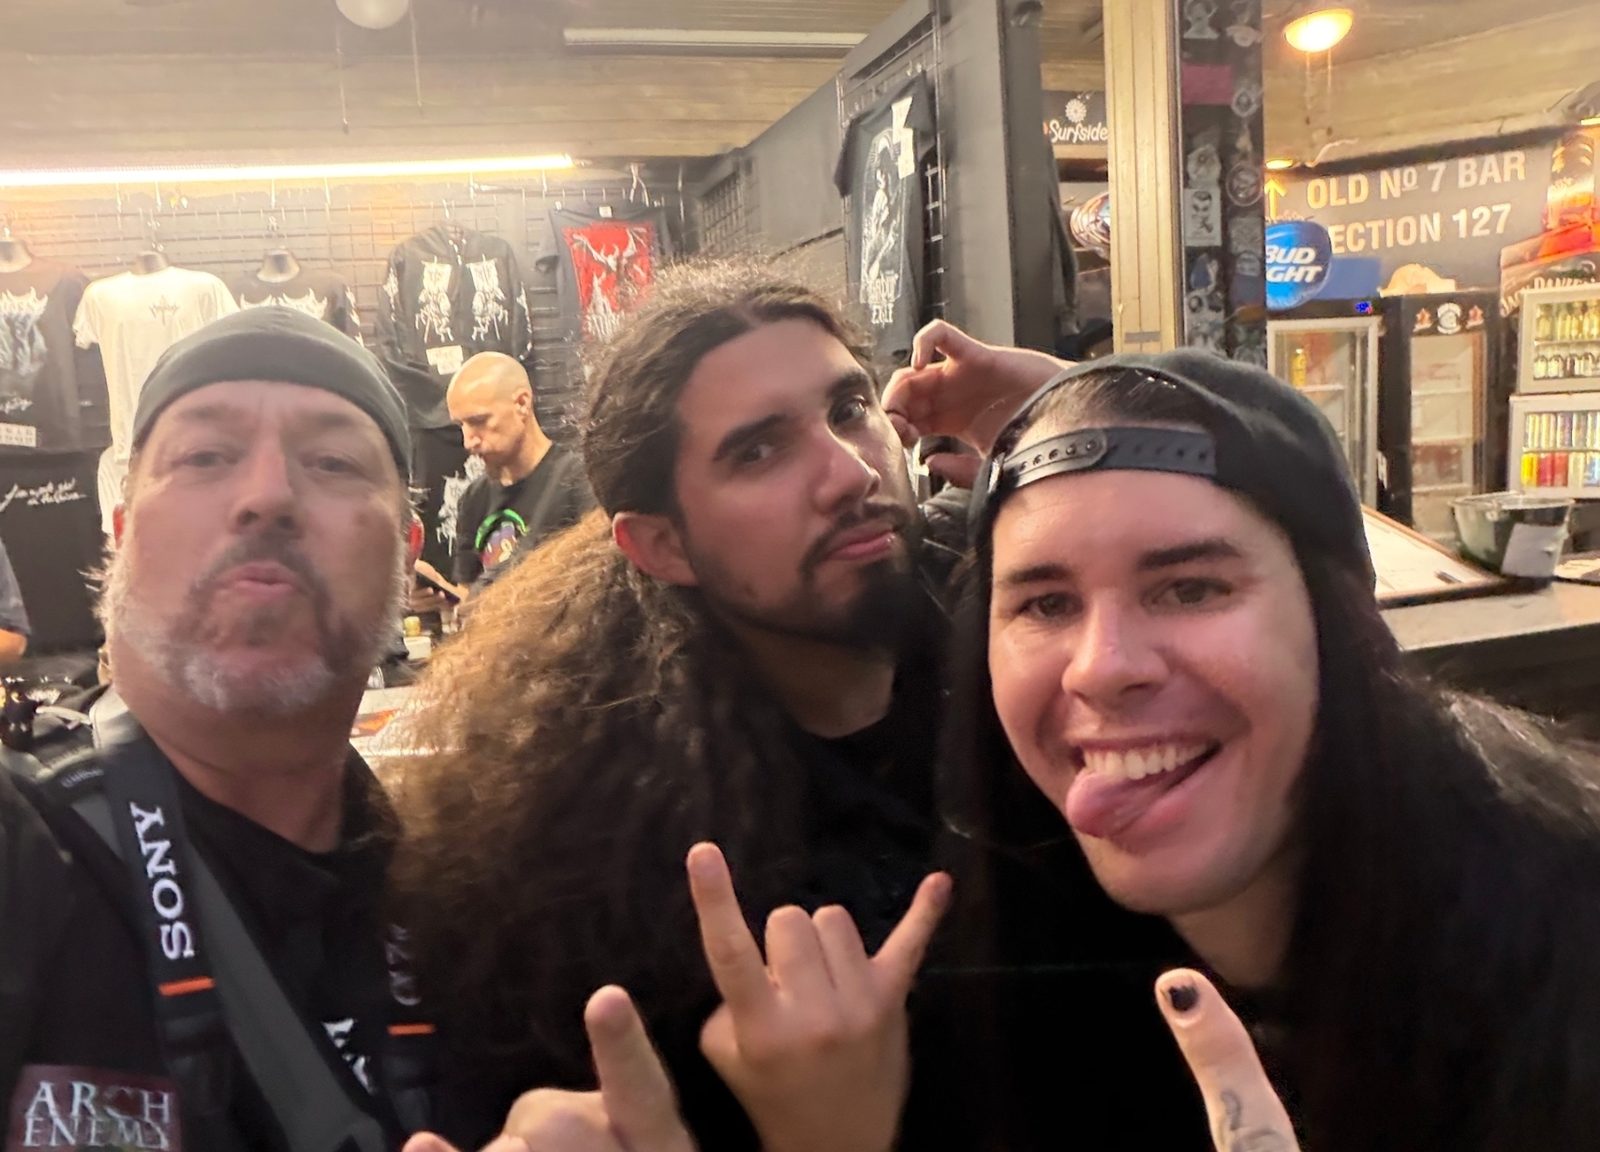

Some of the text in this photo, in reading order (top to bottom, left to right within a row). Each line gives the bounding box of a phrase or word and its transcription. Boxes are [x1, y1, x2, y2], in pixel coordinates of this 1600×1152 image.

[1049, 119, 1108, 143] Surfside
[1307, 173, 1370, 209] OLD
[1428, 163, 1447, 192] 7
[1457, 151, 1526, 189] BAR
[1328, 211, 1441, 255] ECTION
[1451, 203, 1512, 239] 127
[1265, 265, 1323, 284] GHT
[129, 801, 195, 961] SONY
[25, 1080, 172, 1124] ARCH
[23, 1114, 169, 1150] ENEMY
